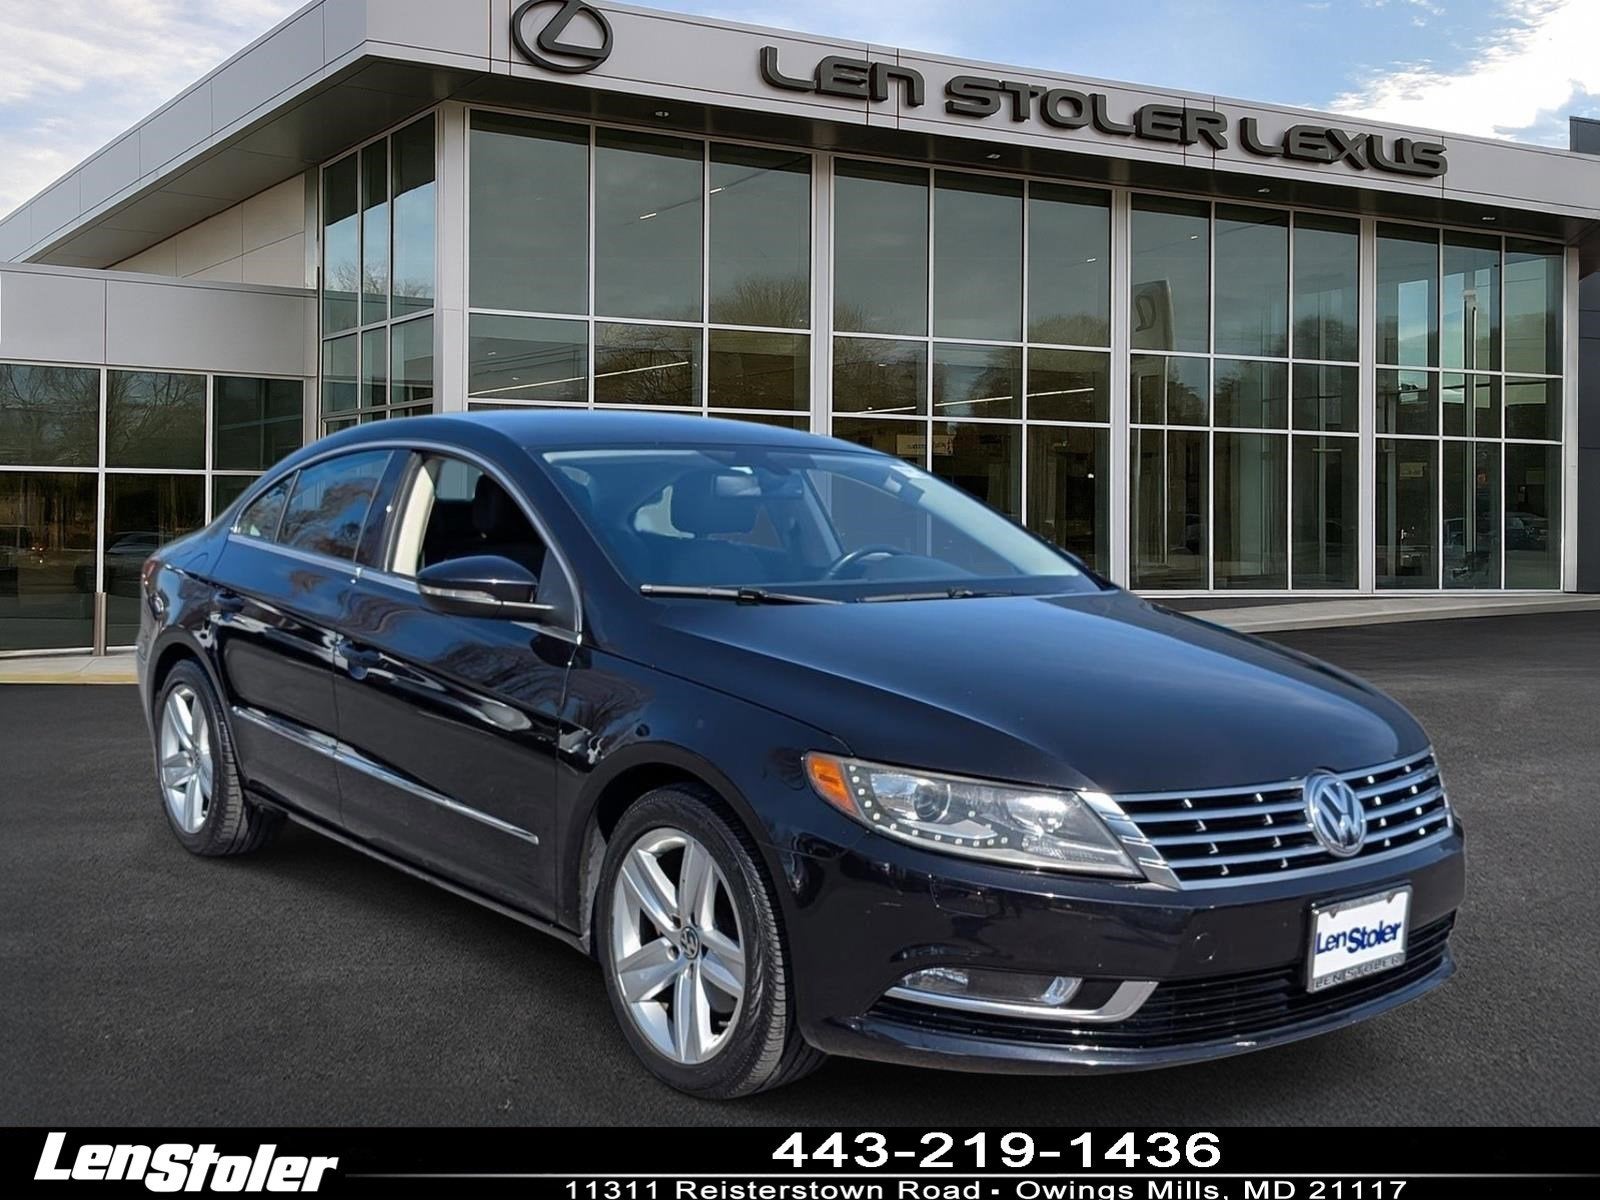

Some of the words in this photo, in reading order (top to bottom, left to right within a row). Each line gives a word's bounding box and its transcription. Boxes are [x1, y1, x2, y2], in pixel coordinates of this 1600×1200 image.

[759, 46, 925, 107] LEN
[945, 74, 1229, 150] STOLER
[1239, 116, 1448, 178] LEXUS
[1314, 920, 1402, 955] LenStoler
